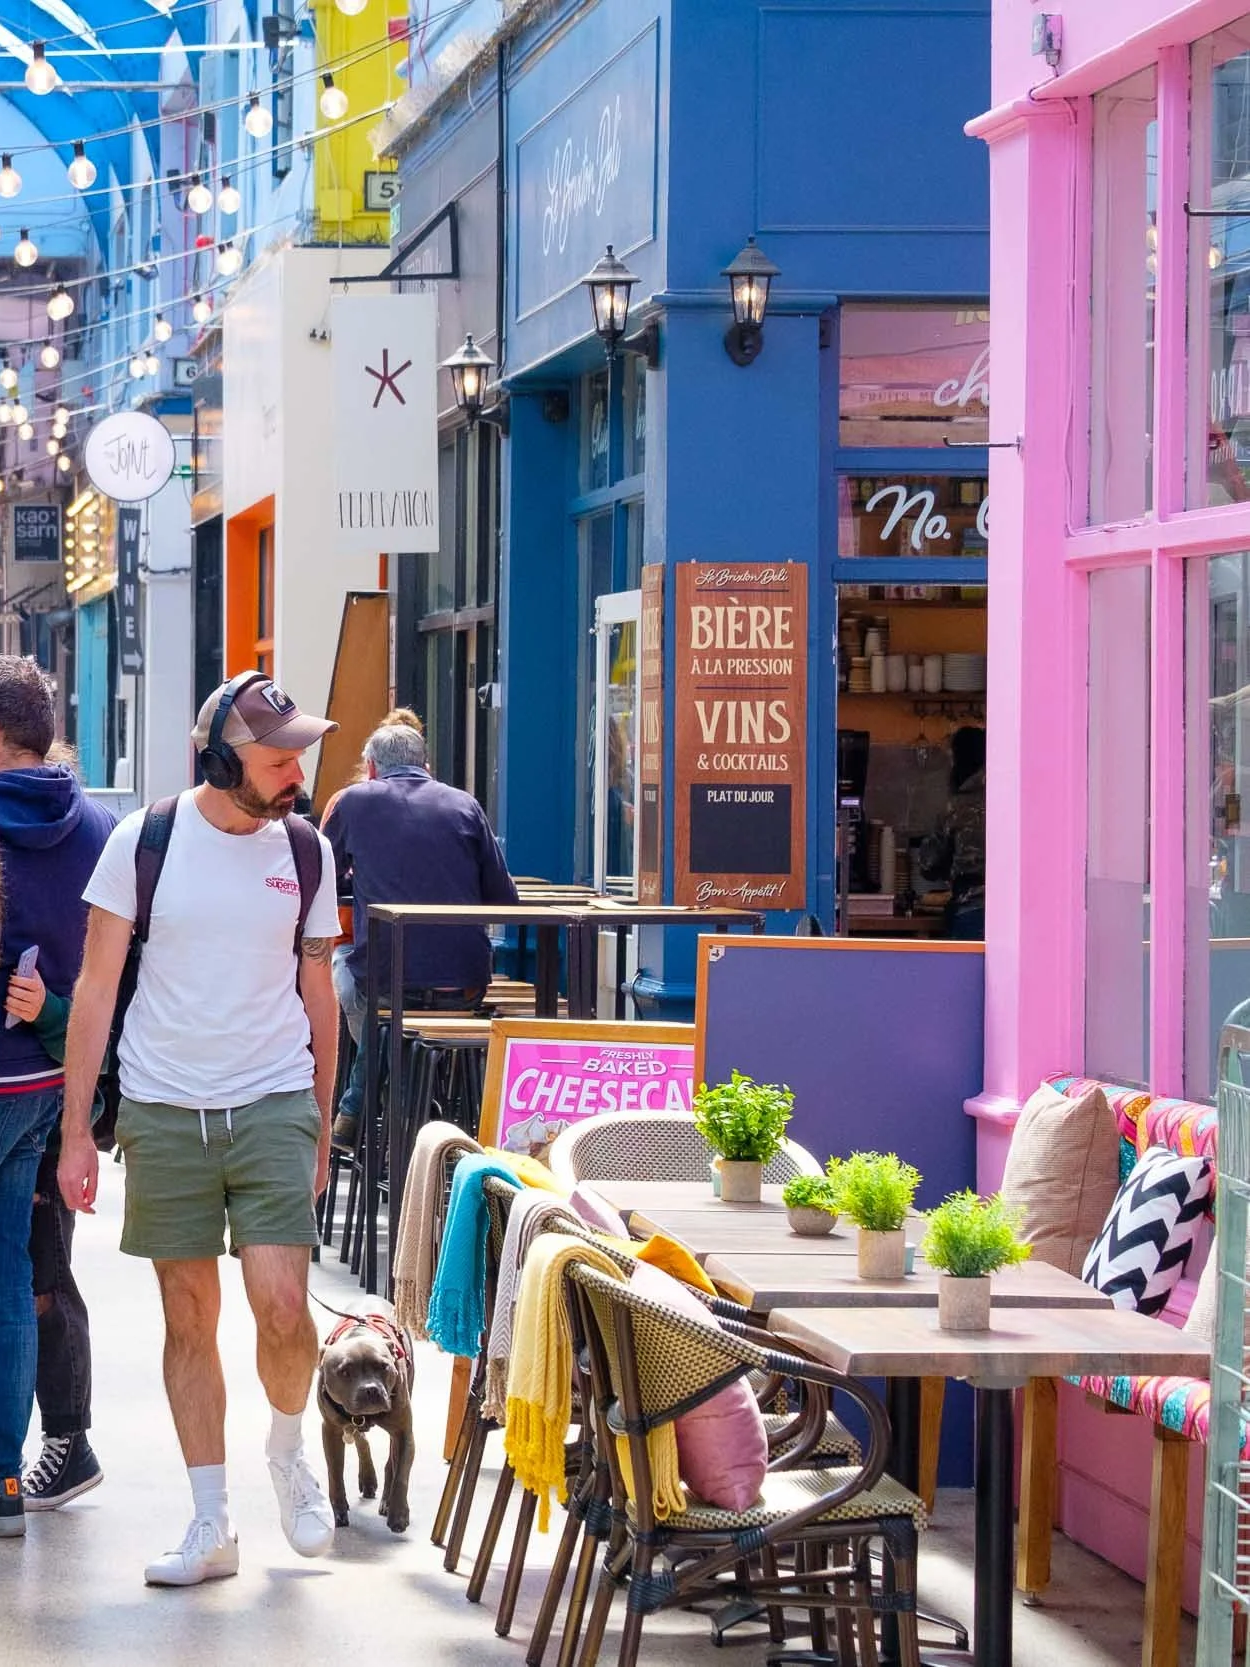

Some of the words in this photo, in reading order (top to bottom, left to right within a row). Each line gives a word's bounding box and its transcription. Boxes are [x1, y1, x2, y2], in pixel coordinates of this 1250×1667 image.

[338, 490, 434, 529] FEDERATION
[865, 484, 951, 550] No.
[122, 518, 138, 640] WINE
[715, 567, 759, 586] Brixton
[690, 597, 794, 650] BIÈRE
[691, 655, 701, 675] À
[705, 659, 724, 675] LA
[727, 659, 793, 675] PRESSION
[694, 700, 791, 744] VINS
[697, 755, 709, 770] &
[713, 753, 788, 771] COCKTAILS
[707, 790, 733, 803] PLAT
[734, 790, 748, 803] DU
[749, 790, 775, 803] JOUR
[696, 880, 729, 902] Bon
[600, 1049, 654, 1060] FRESHLY
[582, 1057, 668, 1076] BAKED
[508, 1068, 694, 1113] CHEESECA
